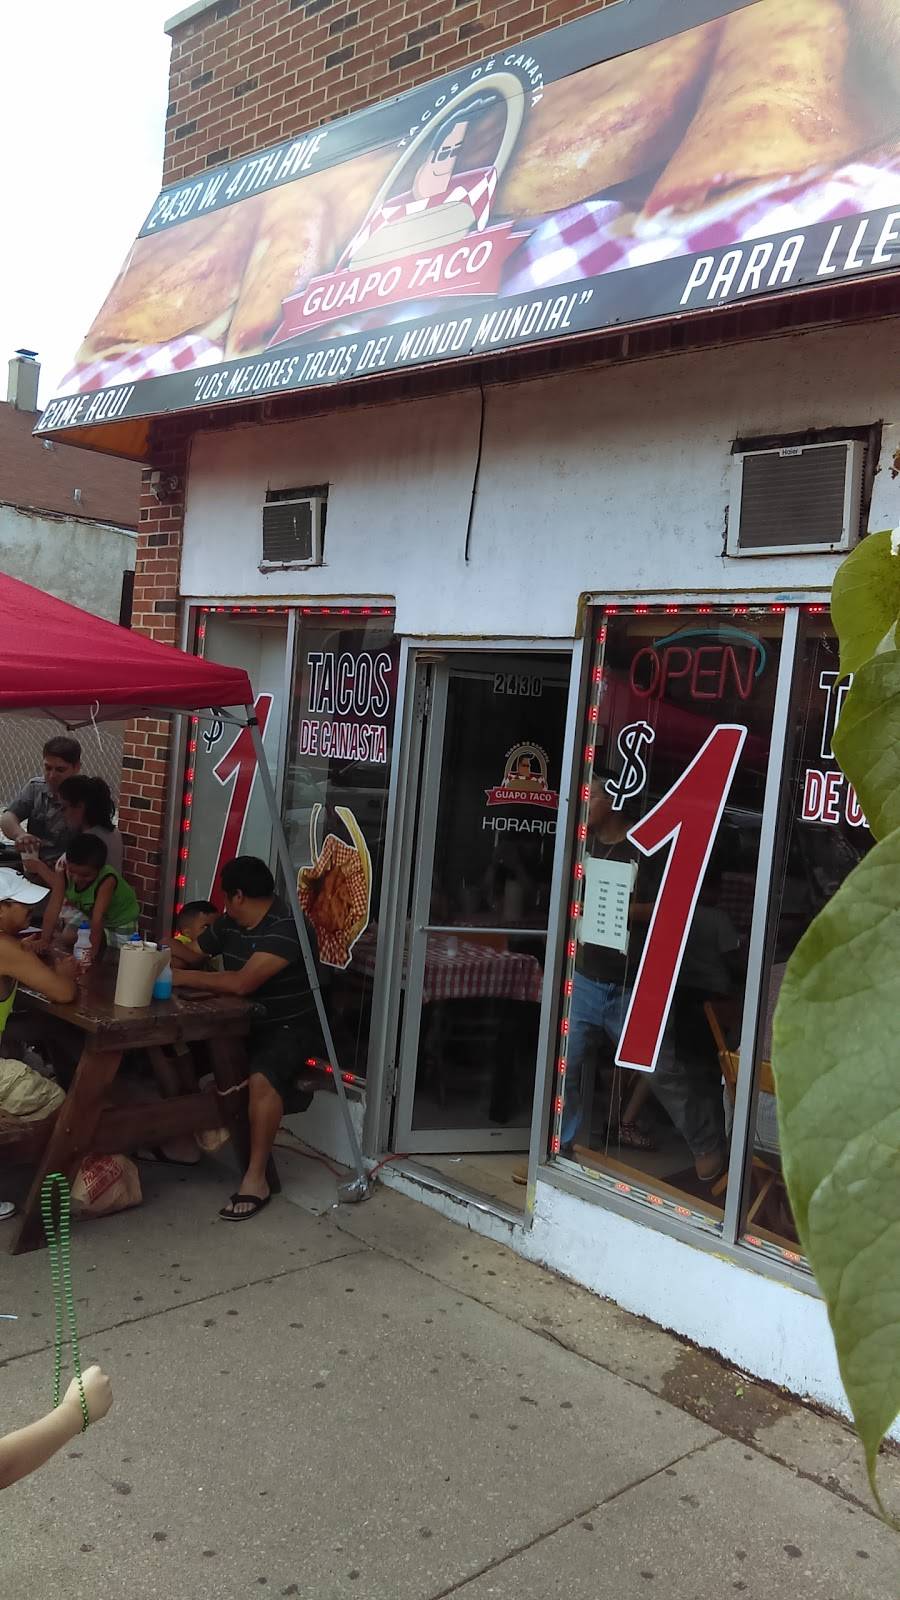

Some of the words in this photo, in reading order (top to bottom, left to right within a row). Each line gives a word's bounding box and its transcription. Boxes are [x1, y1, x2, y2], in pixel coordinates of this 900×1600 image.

[397, 83, 460, 147] TACOS
[471, 60, 496, 80] DE
[504, 54, 544, 109] CANASTA
[147, 182, 201, 229] 2430
[198, 172, 228, 211] W.
[225, 149, 283, 200] 47TH
[274, 131, 328, 181] AVE
[302, 266, 402, 316] GUAPO
[408, 240, 493, 289] TACO
[679, 234, 805, 305] PARA
[225, 356, 300, 396] MEJORES
[298, 344, 358, 382] TACOS
[356, 335, 394, 372] DEL
[394, 317, 473, 363] MUNDO
[36, 395, 90, 430] COME
[84, 385, 136, 422] AQUI
[307, 652, 392, 718] TACOS
[495, 673, 541, 696] 2430
[630, 646, 757, 699] OPEN
[300, 719, 320, 756] DE
[320, 721, 387, 763] CANASTA
[495, 790, 527, 800] GUAPO
[529, 792, 552, 802] TACO
[802, 768, 845, 824] DE
[482, 816, 557, 834] HORARIO
